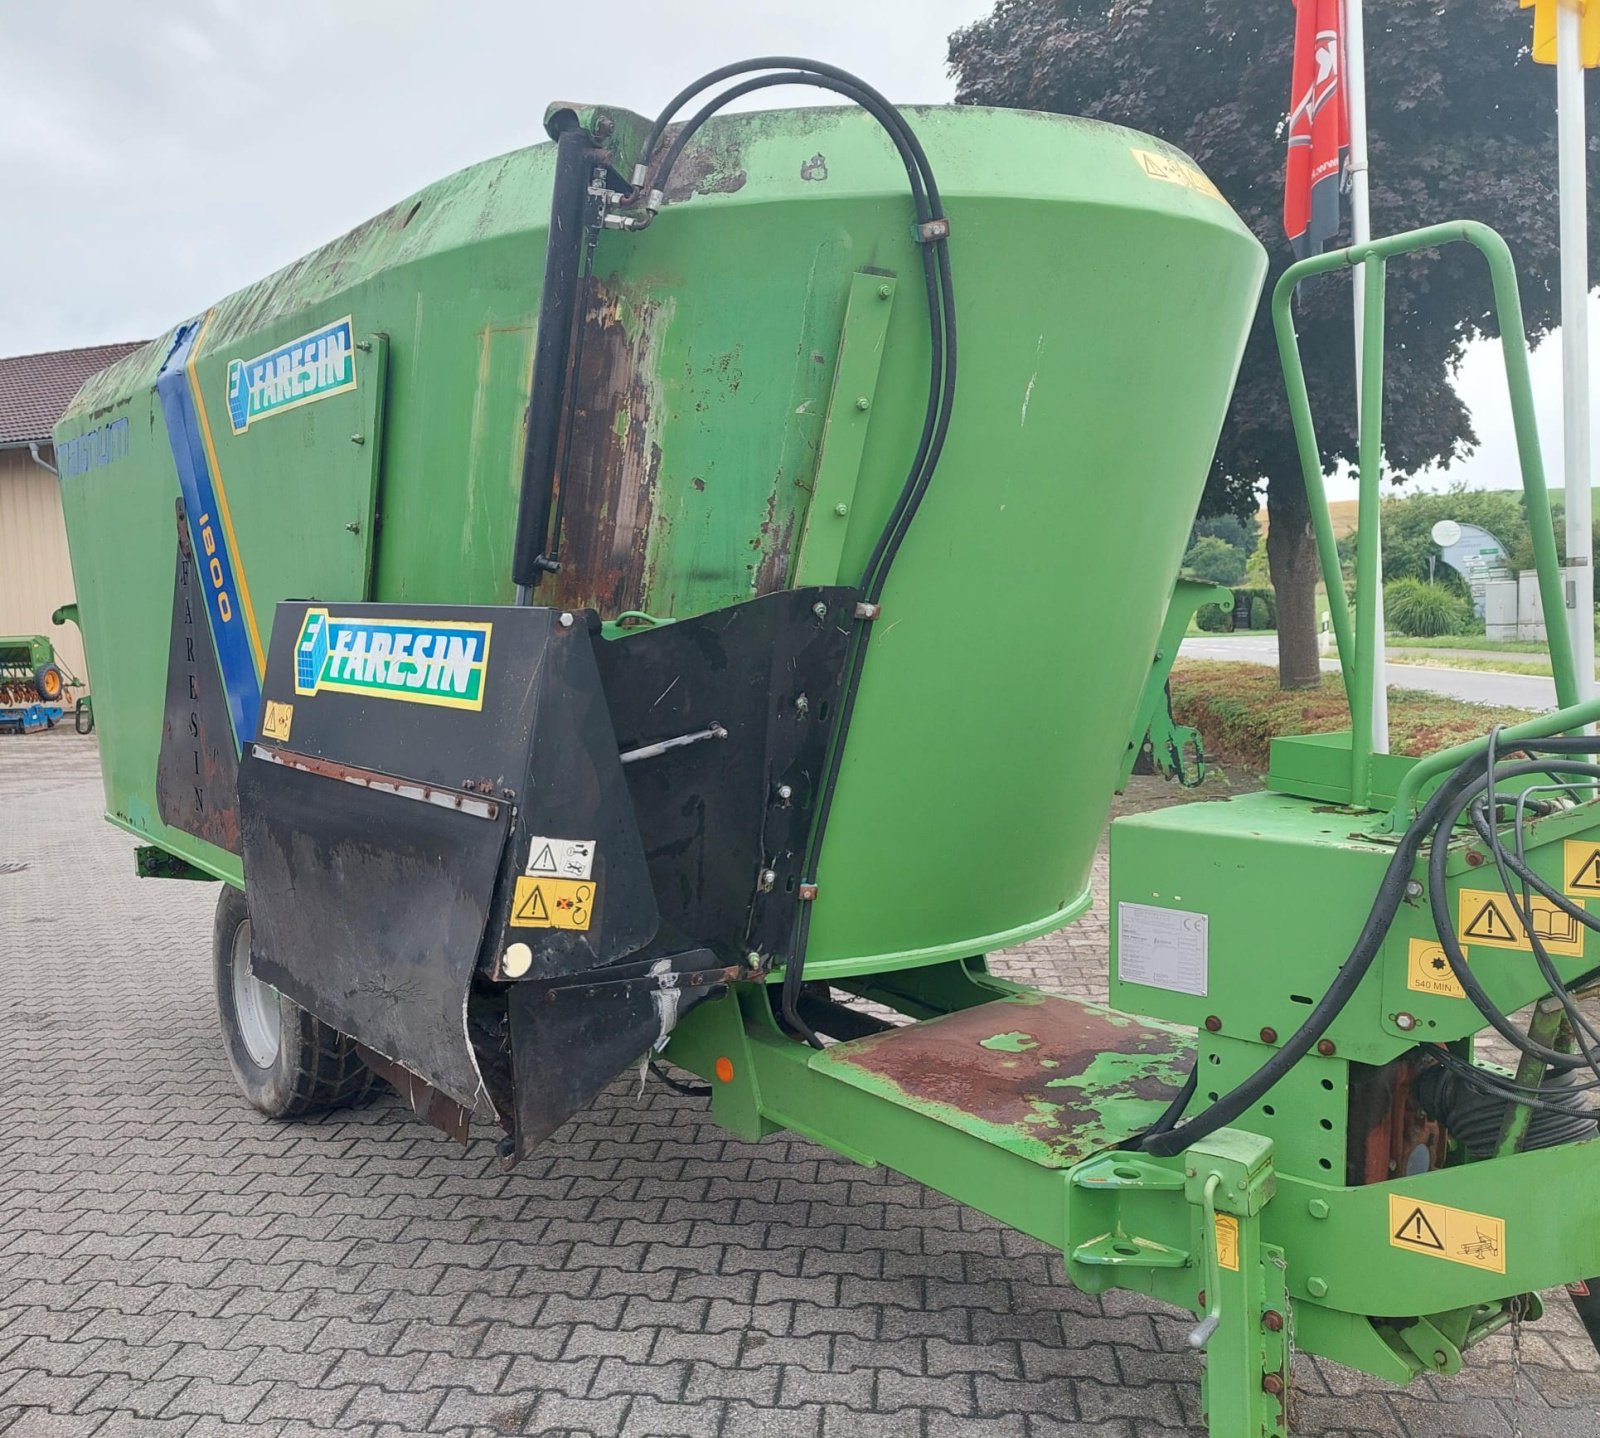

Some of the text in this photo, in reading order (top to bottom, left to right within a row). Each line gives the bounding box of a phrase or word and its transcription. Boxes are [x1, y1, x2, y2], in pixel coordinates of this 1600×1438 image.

[252, 330, 346, 411] FARESIN
[199, 513, 232, 623] 1800
[181, 560, 204, 814] FARESIN
[329, 630, 478, 693] FARESIN
[1415, 979, 1432, 989] 540
